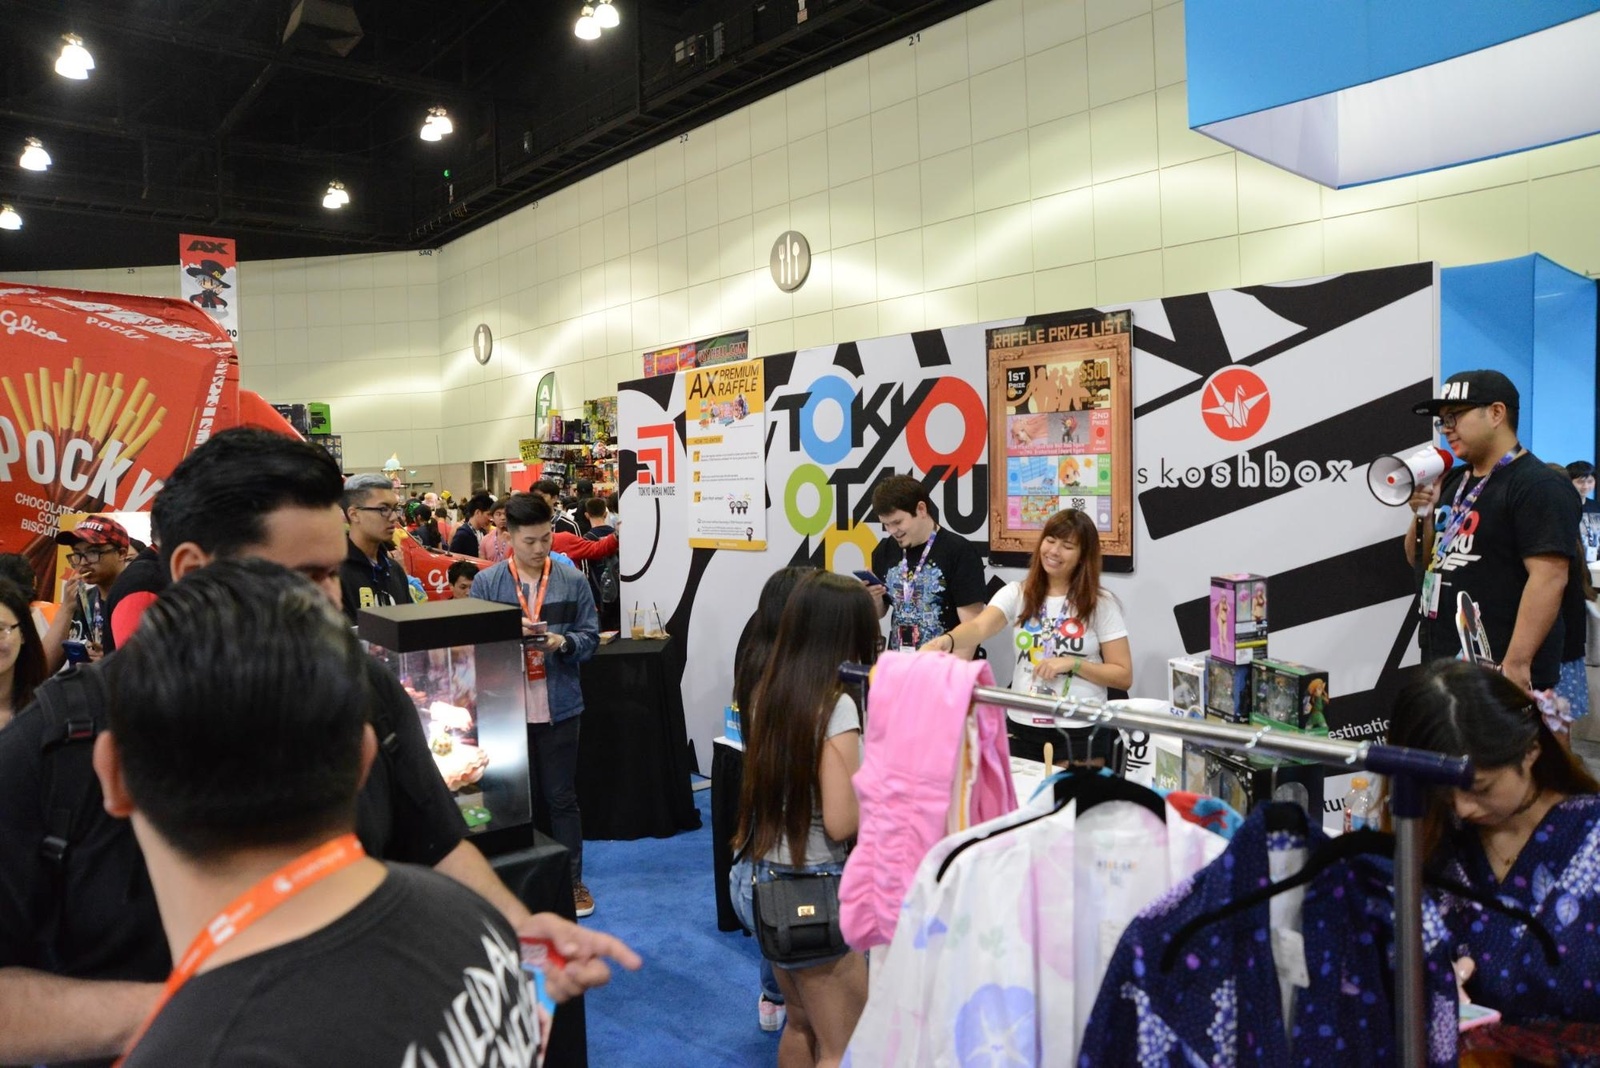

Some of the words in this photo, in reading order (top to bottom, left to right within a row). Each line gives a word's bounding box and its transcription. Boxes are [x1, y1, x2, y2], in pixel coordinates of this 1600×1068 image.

[908, 33, 921, 46] 21
[679, 133, 689, 143] 22
[187, 240, 230, 255] AX
[0, 310, 68, 342] Glico
[993, 328, 1045, 348] RAFFLE
[1048, 322, 1088, 342] PRIZE
[1091, 318, 1123, 337] LIST
[720, 364, 760, 381] PREMIUM
[1008, 370, 1026, 382] 1ST
[1080, 361, 1108, 381] $500
[689, 370, 719, 400] AX
[718, 377, 758, 396] RAFFLE
[1092, 412, 1109, 420] 2ND
[771, 375, 988, 482] TOKYO
[1136, 452, 1351, 487] skoshbox
[663, 486, 675, 495] MODE
[14, 492, 75, 515] CHOCOLATE
